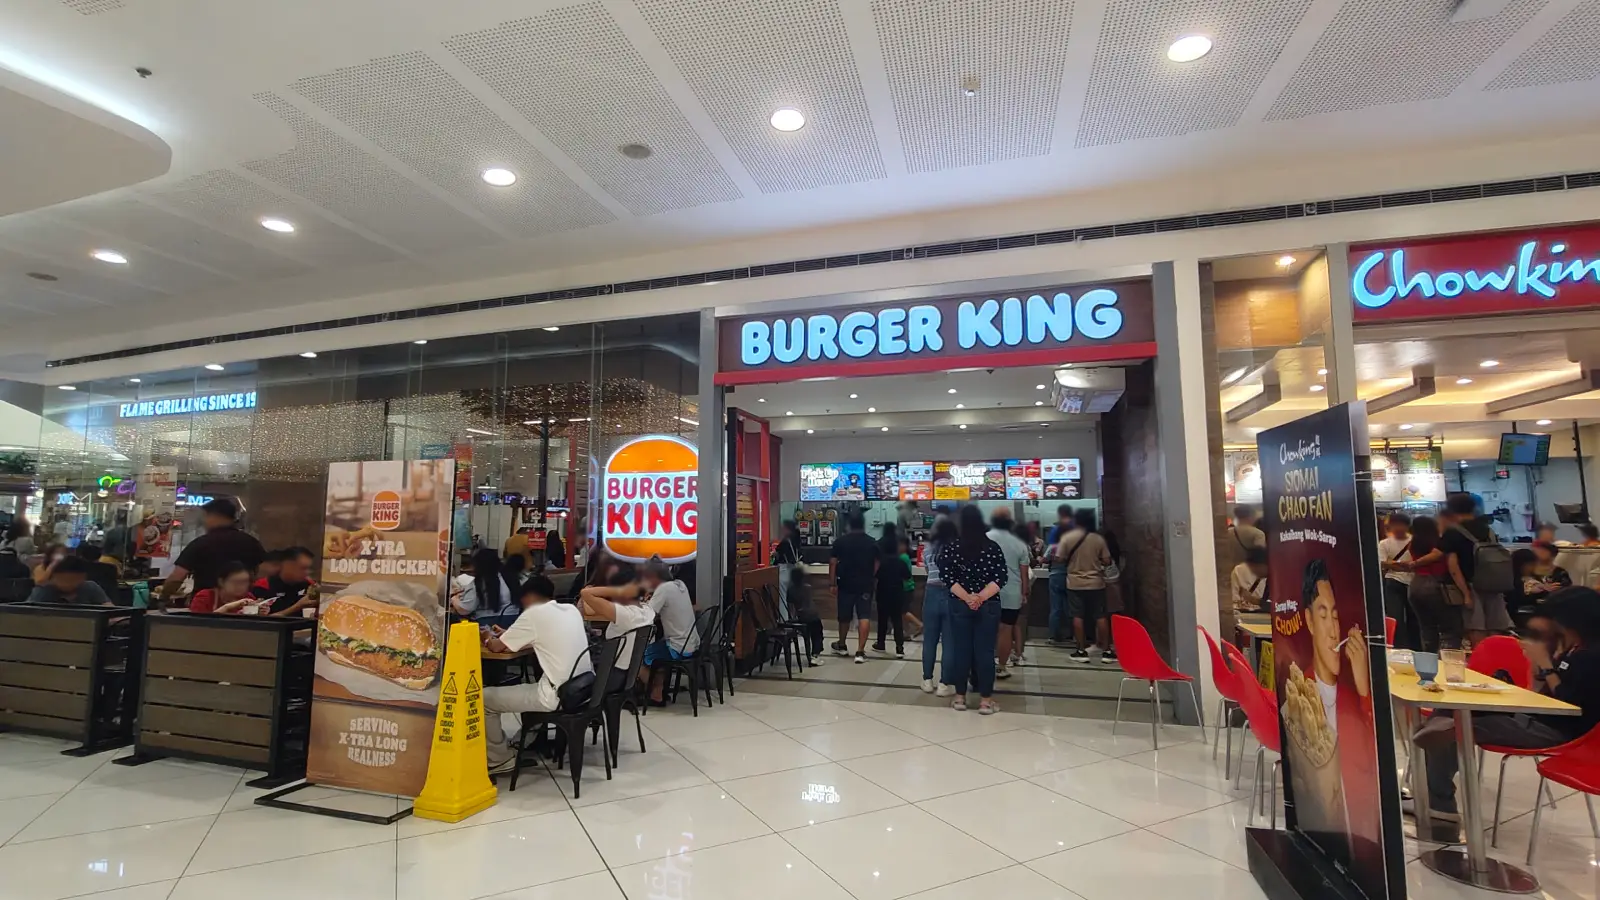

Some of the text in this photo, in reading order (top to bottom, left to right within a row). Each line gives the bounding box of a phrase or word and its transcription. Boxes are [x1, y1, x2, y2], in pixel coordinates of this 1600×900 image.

[740, 288, 1123, 366] BURGER KING
[120, 401, 154, 418] FLAME
[155, 396, 207, 415] GRILLING
[208, 393, 244, 411] SINCE
[950, 464, 987, 477] Order
[1284, 466, 1319, 493] SIOMAI
[373, 502, 400, 510] BURGER
[606, 475, 698, 535] BURGER KING
[1279, 489, 1332, 522] CHAO FAN
[372, 510, 399, 521] KING
[361, 540, 406, 556] X-TRA
[1304, 528, 1337, 548] Wok-Sarap
[329, 559, 438, 576] LONG CHICKEN
[1275, 611, 1303, 636] CHOW!
[350, 717, 399, 736] SERVING
[338, 732, 407, 752] X-TRA LONG
[347, 746, 396, 767] REALNESS
